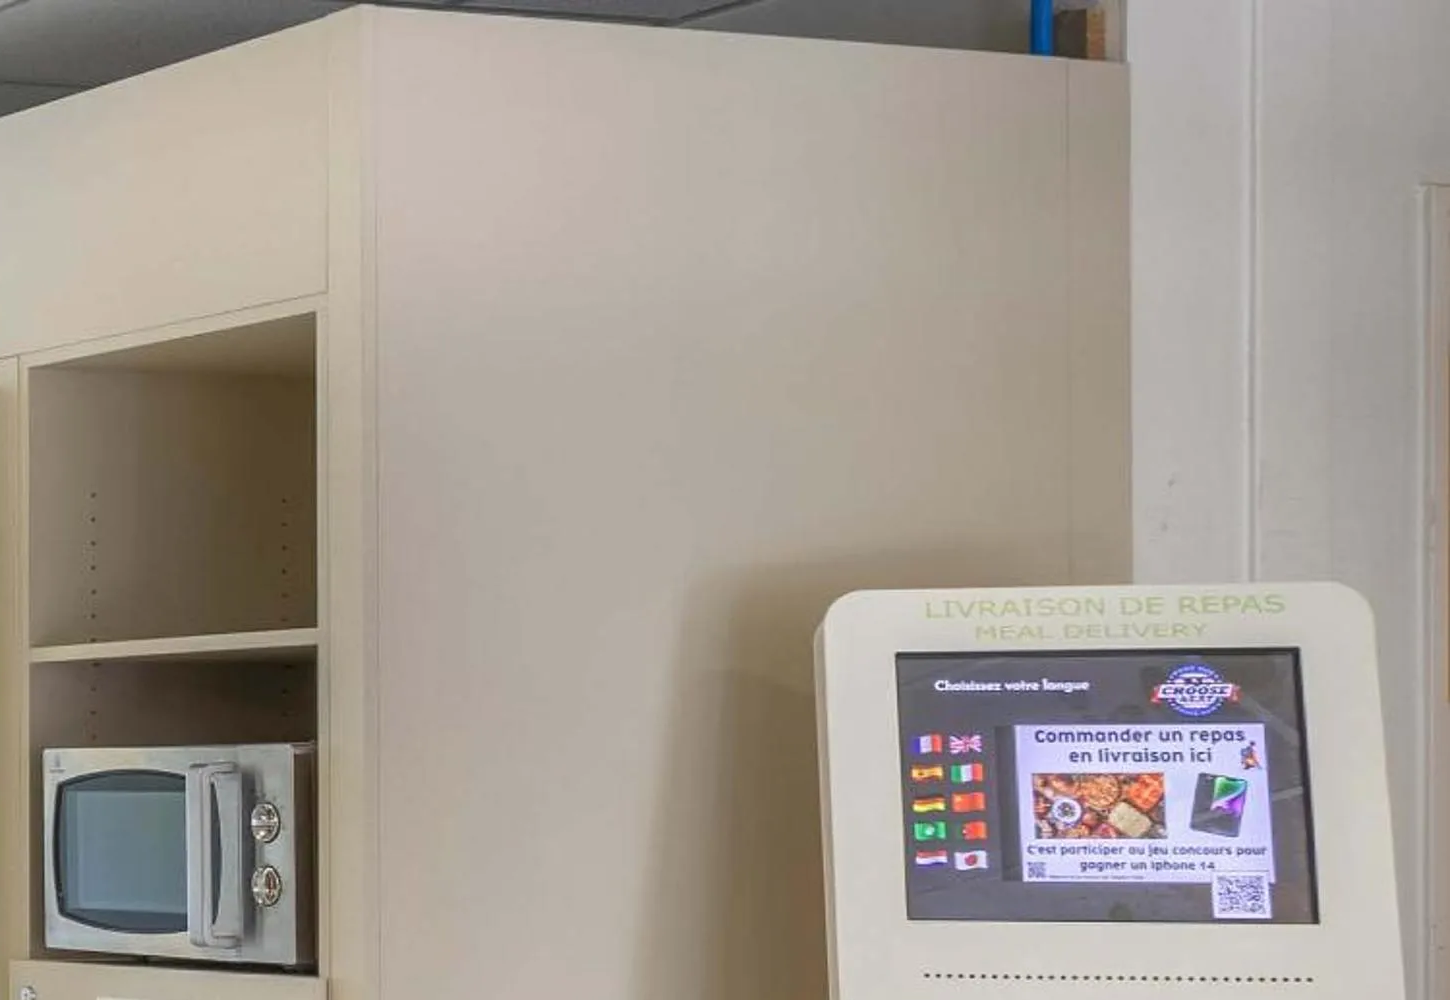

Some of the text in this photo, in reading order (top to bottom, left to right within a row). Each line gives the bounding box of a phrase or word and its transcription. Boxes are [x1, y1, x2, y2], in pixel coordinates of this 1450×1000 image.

[925, 594, 1286, 619] LIVRAISON DE REPAS
[975, 622, 1207, 640] MEAL DELIVERY
[933, 677, 1090, 694] Choisissez votre longue
[1034, 728, 1246, 746] Commander un repas
[1069, 747, 1212, 763] en livraison ici
[1061, 843, 1123, 857] participer
[1128, 846, 1145, 856] au
[1172, 845, 1232, 857] concours
[1236, 845, 1266, 858] pour
[1080, 861, 1127, 872] gagner
[1130, 861, 1147, 870] un
[1199, 860, 1215, 871] 14
